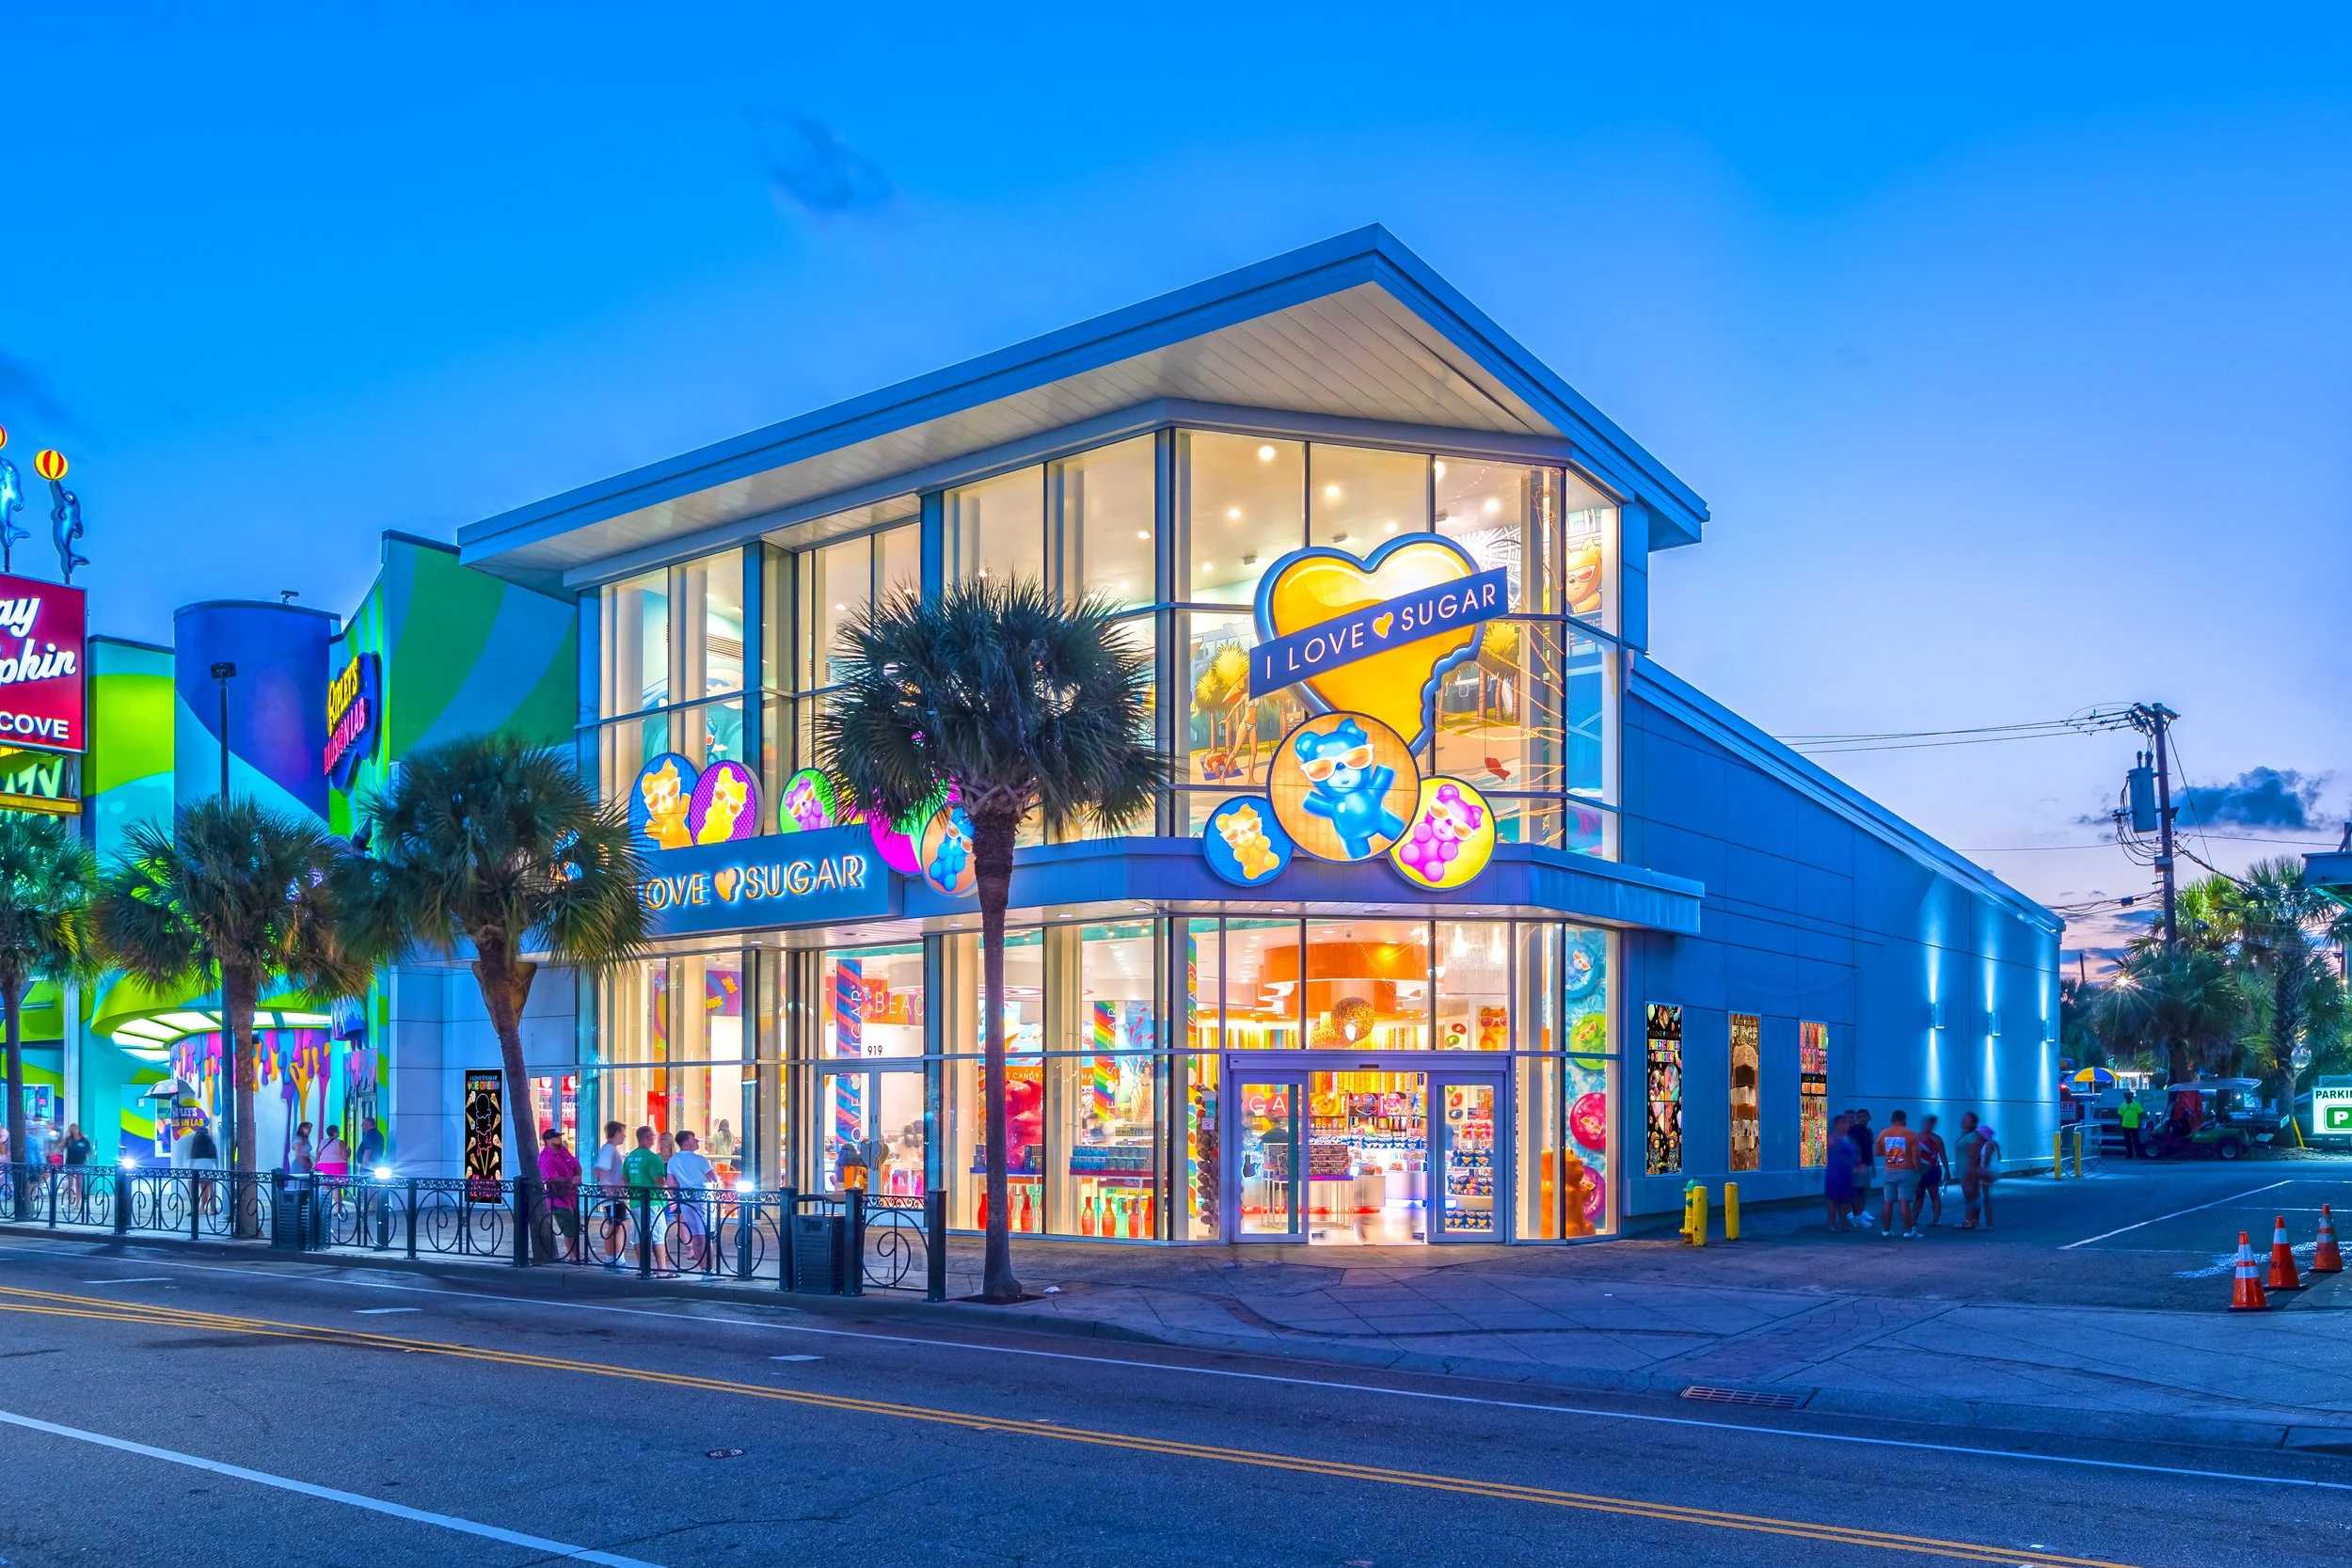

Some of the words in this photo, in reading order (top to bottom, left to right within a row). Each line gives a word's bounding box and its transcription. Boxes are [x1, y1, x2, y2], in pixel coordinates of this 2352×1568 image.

[0, 597, 40, 638] ay
[1266, 656, 1271, 679] I
[1289, 622, 1364, 672] LOVE
[1401, 583, 1496, 631] SUGAR
[0, 638, 76, 684] phin
[327, 656, 358, 736] RIPLEY'S
[0, 711, 70, 739] COVE
[324, 714, 350, 775] ILLUSION
[350, 697, 365, 740] LAB
[644, 872, 706, 910] OVE
[744, 855, 864, 899] SUGAR
[867, 1045, 882, 1055] 919
[1012, 1071, 1041, 1080] CANDY
[172, 1105, 198, 1117] RILEY'S
[191, 1118, 204, 1127] LAB
[850, 1098, 862, 1143] OVE
[2334, 1111, 2349, 1125] P
